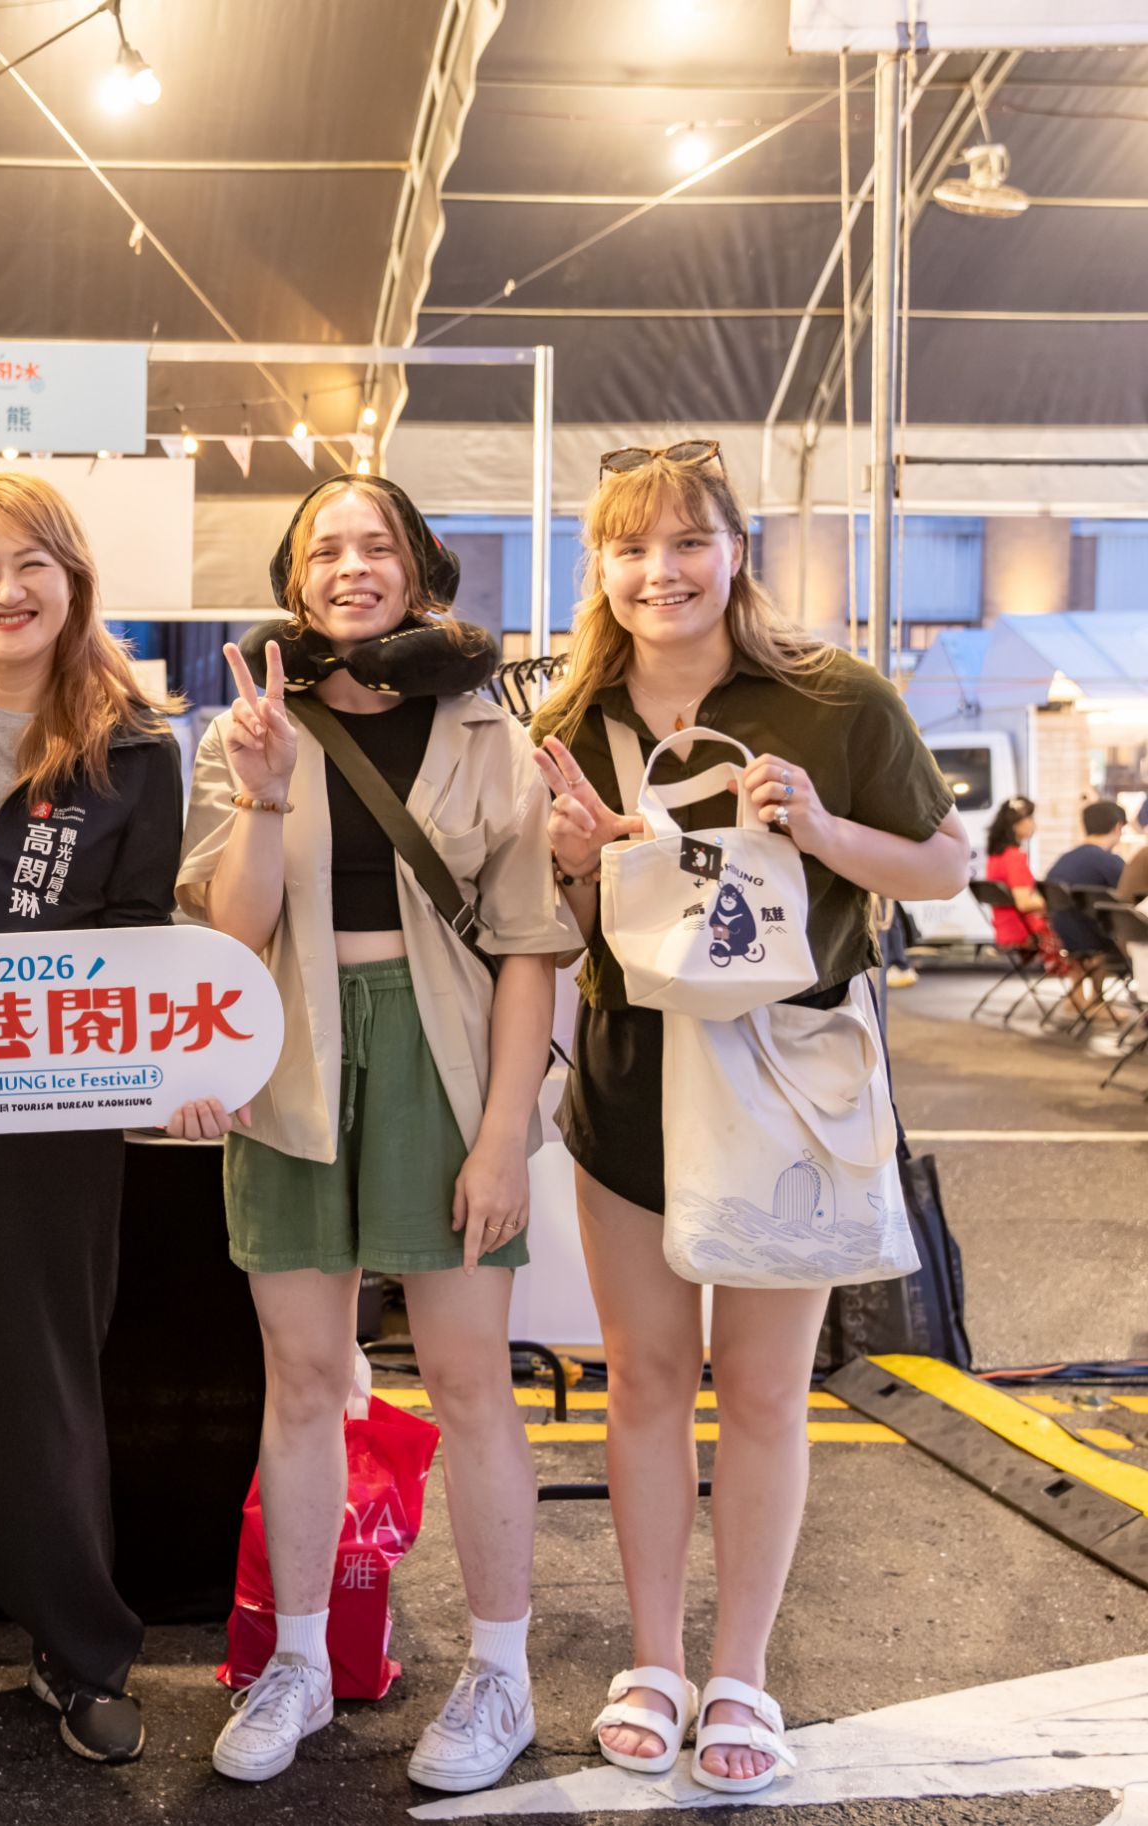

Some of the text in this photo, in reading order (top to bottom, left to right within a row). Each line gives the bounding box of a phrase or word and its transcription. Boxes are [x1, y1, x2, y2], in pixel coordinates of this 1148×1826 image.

[9, 823, 57, 919] 高閔琳
[43, 827, 78, 905] 觀光局局長
[52, 1074, 76, 1089] Ice
[81, 1069, 147, 1087] Festival
[12, 1103, 53, 1112] TOURISM
[57, 1100, 94, 1110] BUREAU
[97, 1098, 152, 1108] KAOHSIUNG
